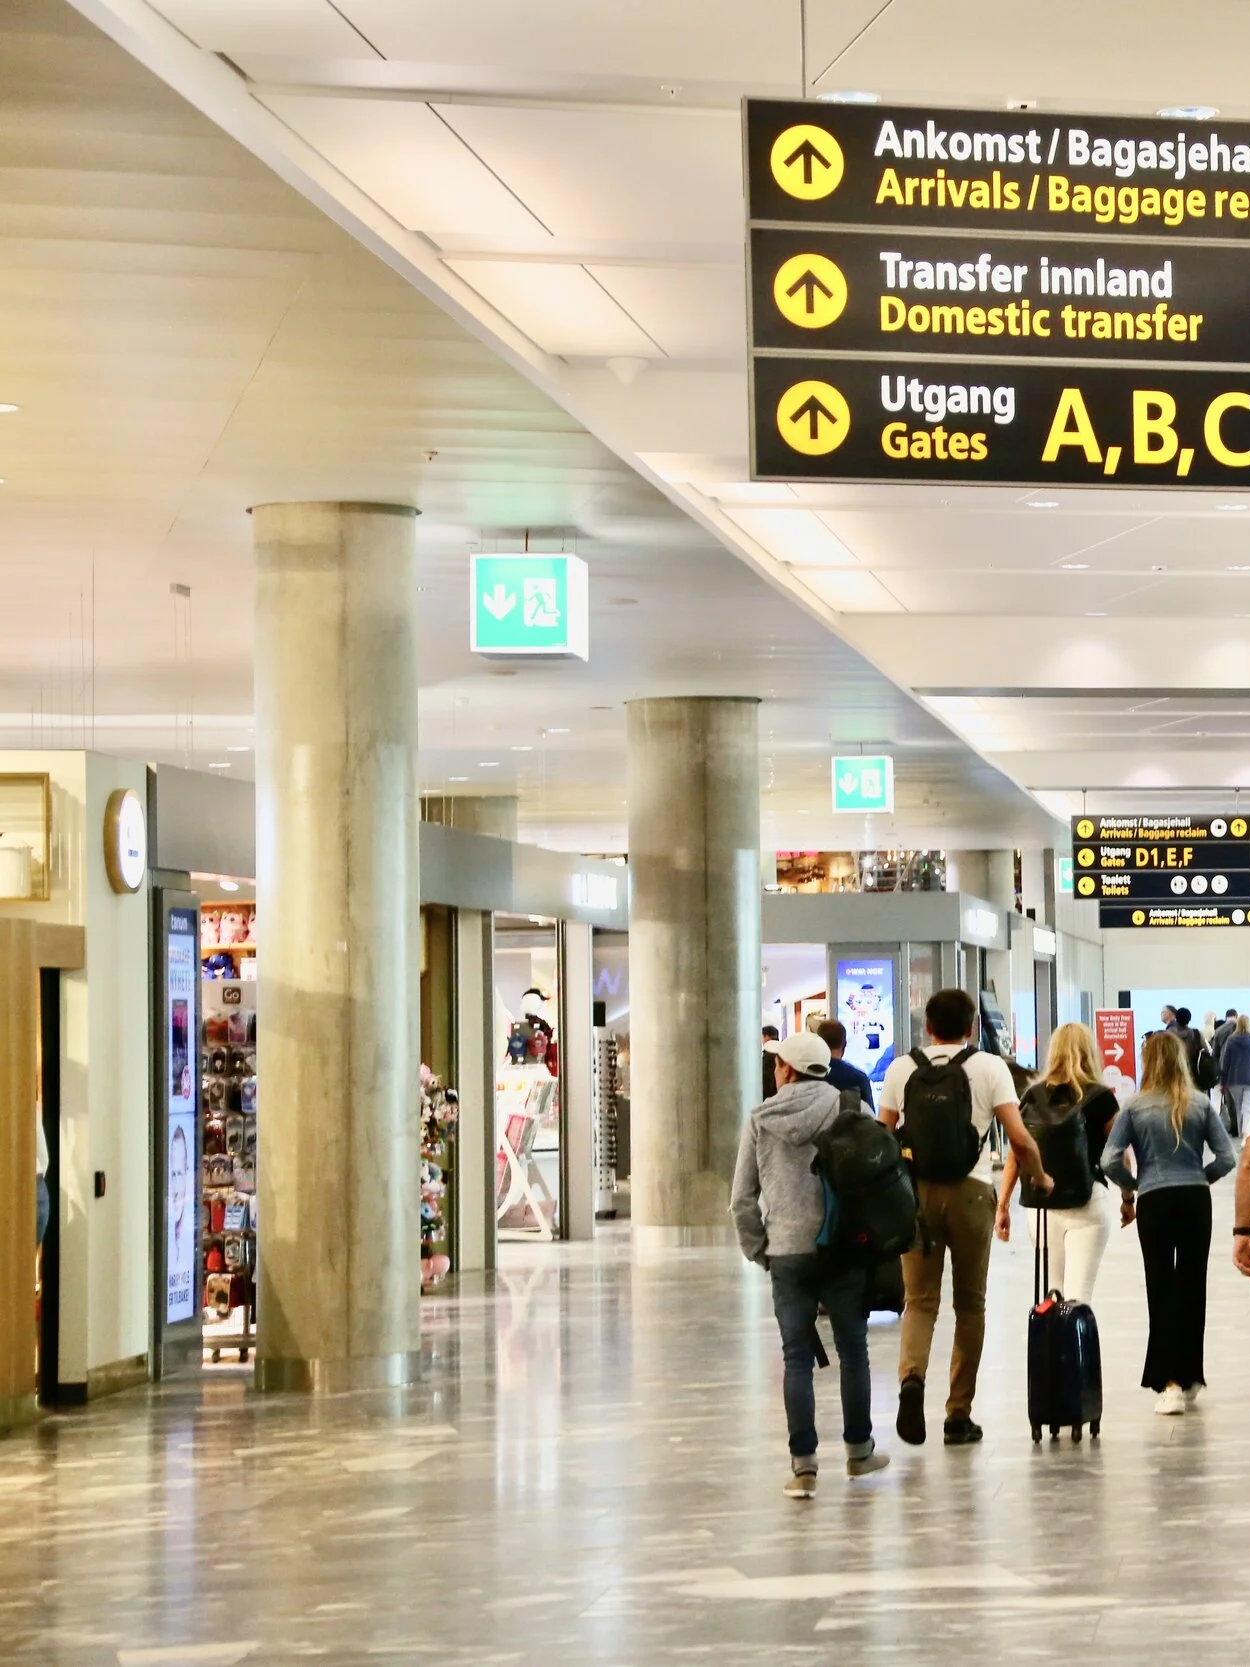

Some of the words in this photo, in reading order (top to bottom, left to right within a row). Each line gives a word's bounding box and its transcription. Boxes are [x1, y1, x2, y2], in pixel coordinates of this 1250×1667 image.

[875, 120, 1041, 164] Ankomst
[876, 168, 1020, 210] Arrivals
[1049, 176, 1206, 225] Baggage
[880, 252, 1028, 293] Transfer
[1041, 257, 1172, 298] innland
[880, 296, 1050, 337] Domestic
[1061, 303, 1203, 341] transfer
[881, 375, 1015, 424] Utgang
[882, 422, 987, 460] Gates
[1100, 818, 1138, 829] Ankomst
[1143, 817, 1191, 829] Bagasjehall
[1100, 828, 1133, 838] Arrivals
[1139, 829, 1175, 840] Baggage
[1176, 828, 1207, 838] reclaim
[1101, 846, 1131, 858] Utgang
[1136, 848, 1193, 868] D1,E,F
[1101, 857, 1126, 867] Gates
[1101, 875, 1131, 885] Toalett
[1102, 885, 1129, 895] Toilets
